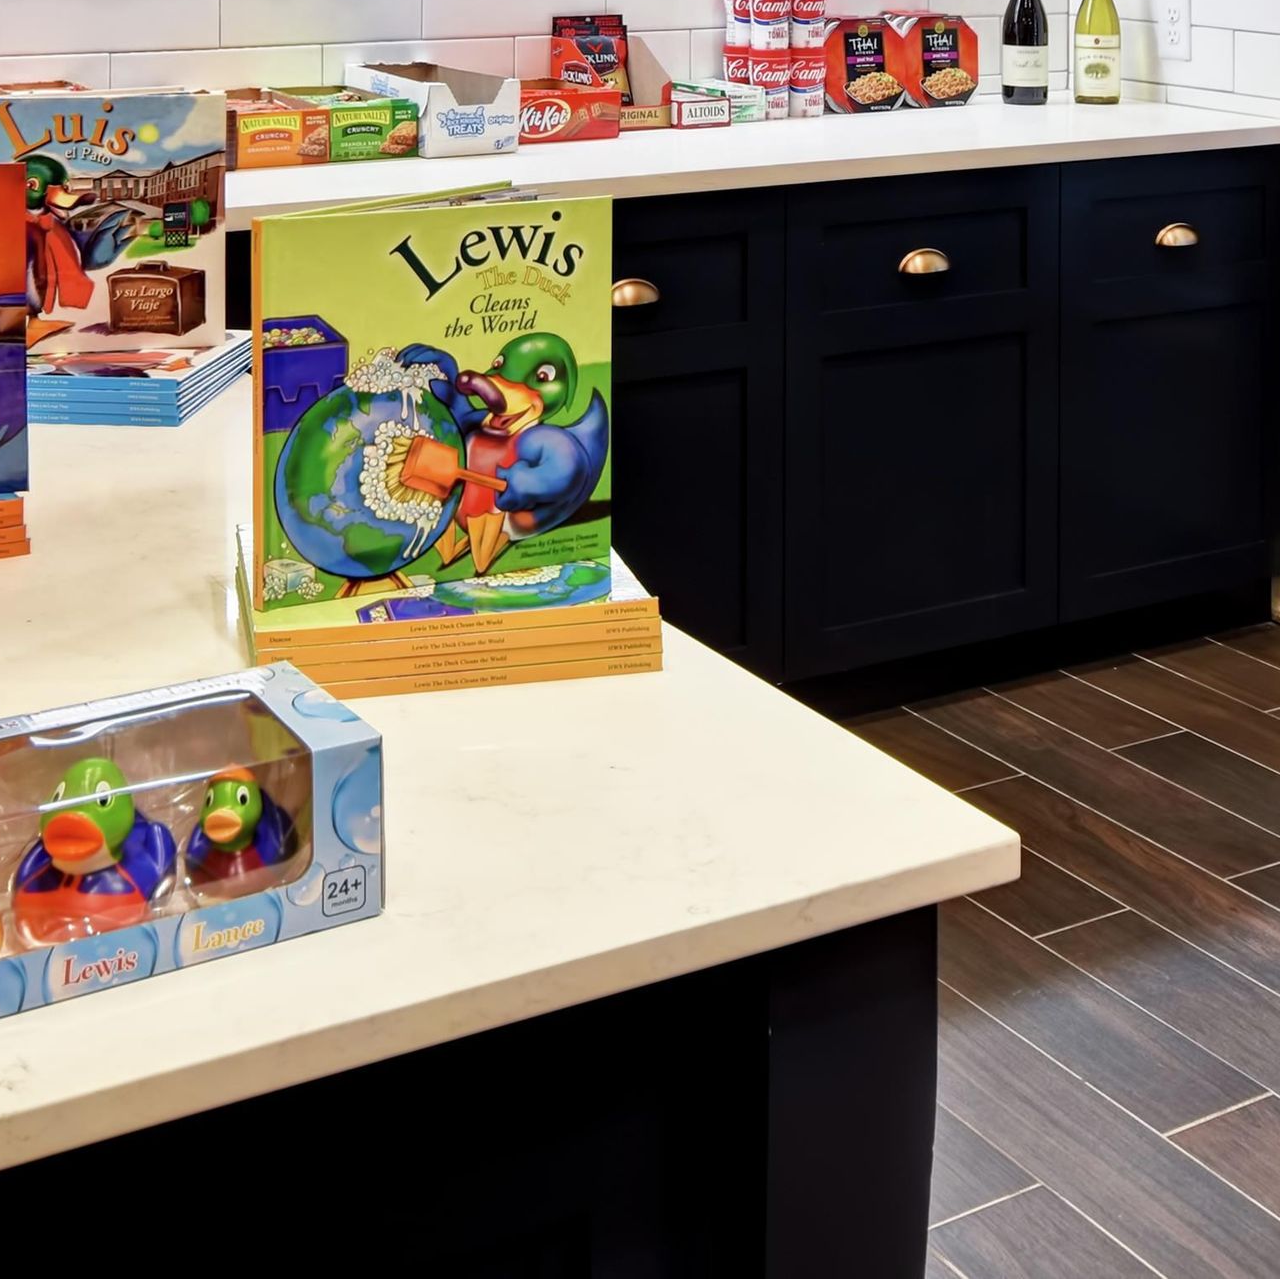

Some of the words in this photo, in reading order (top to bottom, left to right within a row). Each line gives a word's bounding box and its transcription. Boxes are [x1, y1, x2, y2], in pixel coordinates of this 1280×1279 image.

[849, 37, 877, 51] THAI
[925, 34, 953, 48] THAI
[334, 112, 362, 124] NATURE
[362, 111, 389, 122] VALLEY
[520, 105, 568, 133] KitKat
[620, 110, 659, 120] RIGINAL
[687, 106, 725, 118] ALTOIDS
[242, 118, 270, 132] NATURE
[271, 117, 298, 129] VALLEY
[488, 115, 514, 125] original
[255, 132, 289, 140] CRUNCHY
[448, 124, 484, 136] TREATS
[65, 146, 77, 159] el
[80, 148, 112, 166] Pato
[389, 211, 584, 302] Lewis
[113, 289, 123, 300] y
[124, 289, 137, 297] su
[139, 285, 174, 298] Largo
[476, 265, 517, 291] The
[522, 265, 571, 306] Duck
[130, 299, 160, 313] Viaje
[470, 293, 531, 315] Cleans
[444, 318, 473, 339] the
[481, 310, 538, 335] World
[326, 877, 363, 900] 24+
[331, 897, 359, 908] months
[191, 917, 265, 953] Lance
[62, 948, 139, 986] Lewis
